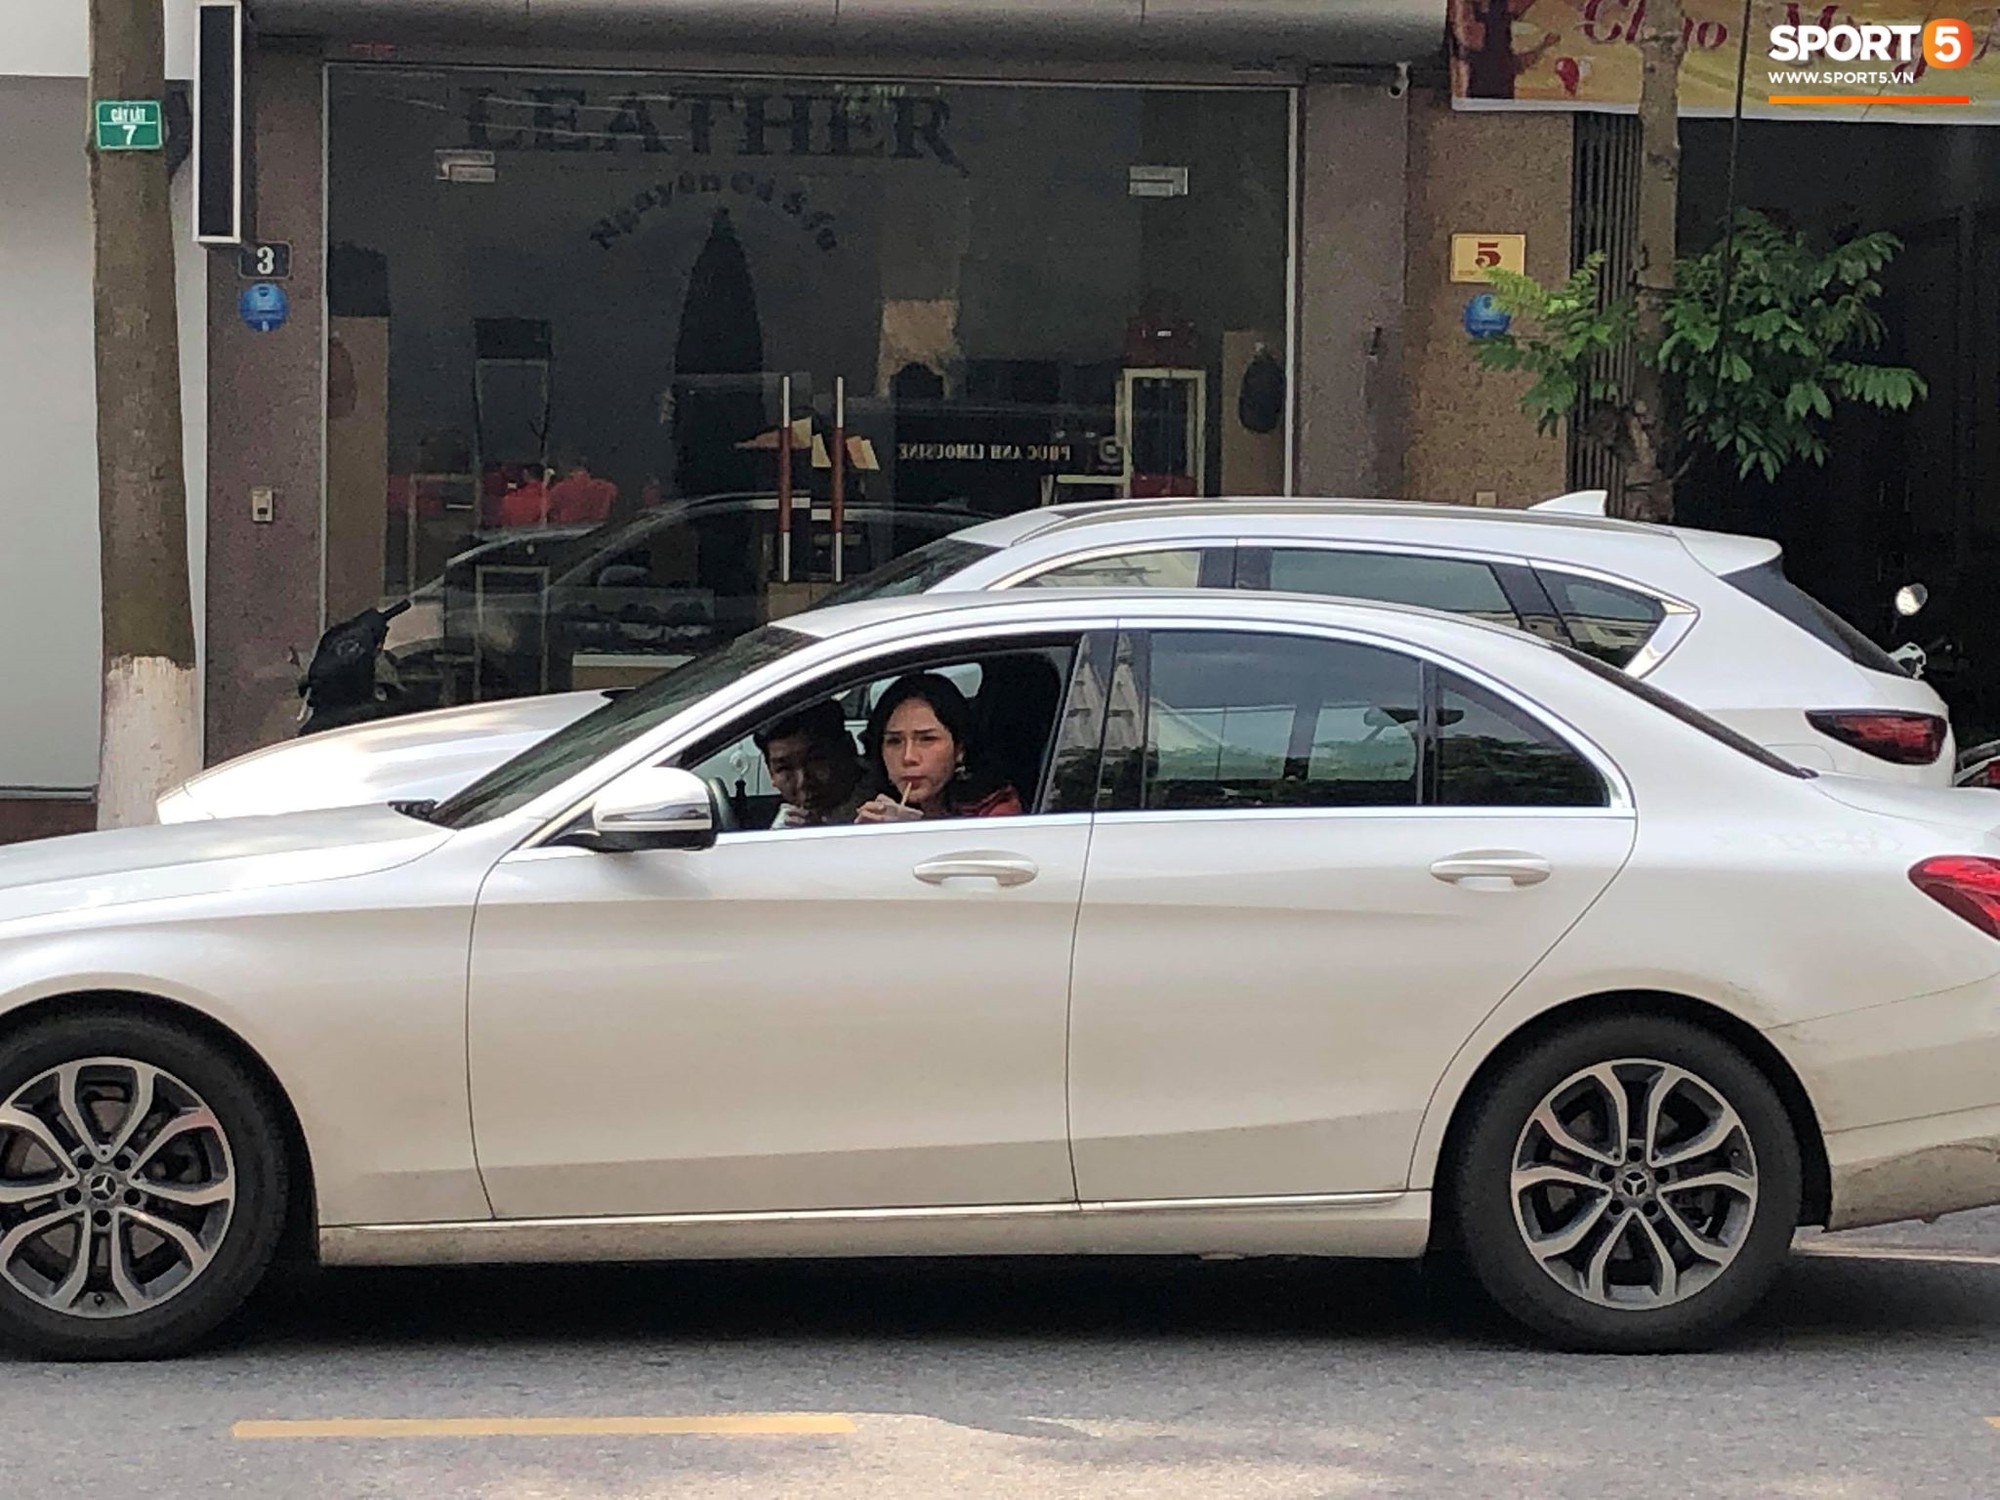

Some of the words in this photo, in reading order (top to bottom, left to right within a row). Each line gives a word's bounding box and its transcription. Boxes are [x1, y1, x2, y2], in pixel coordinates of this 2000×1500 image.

[122, 124, 137, 145] 7
[460, 84, 970, 178] LEATHER
[257, 246, 275, 275] 3
[1475, 242, 1501, 268] 5
